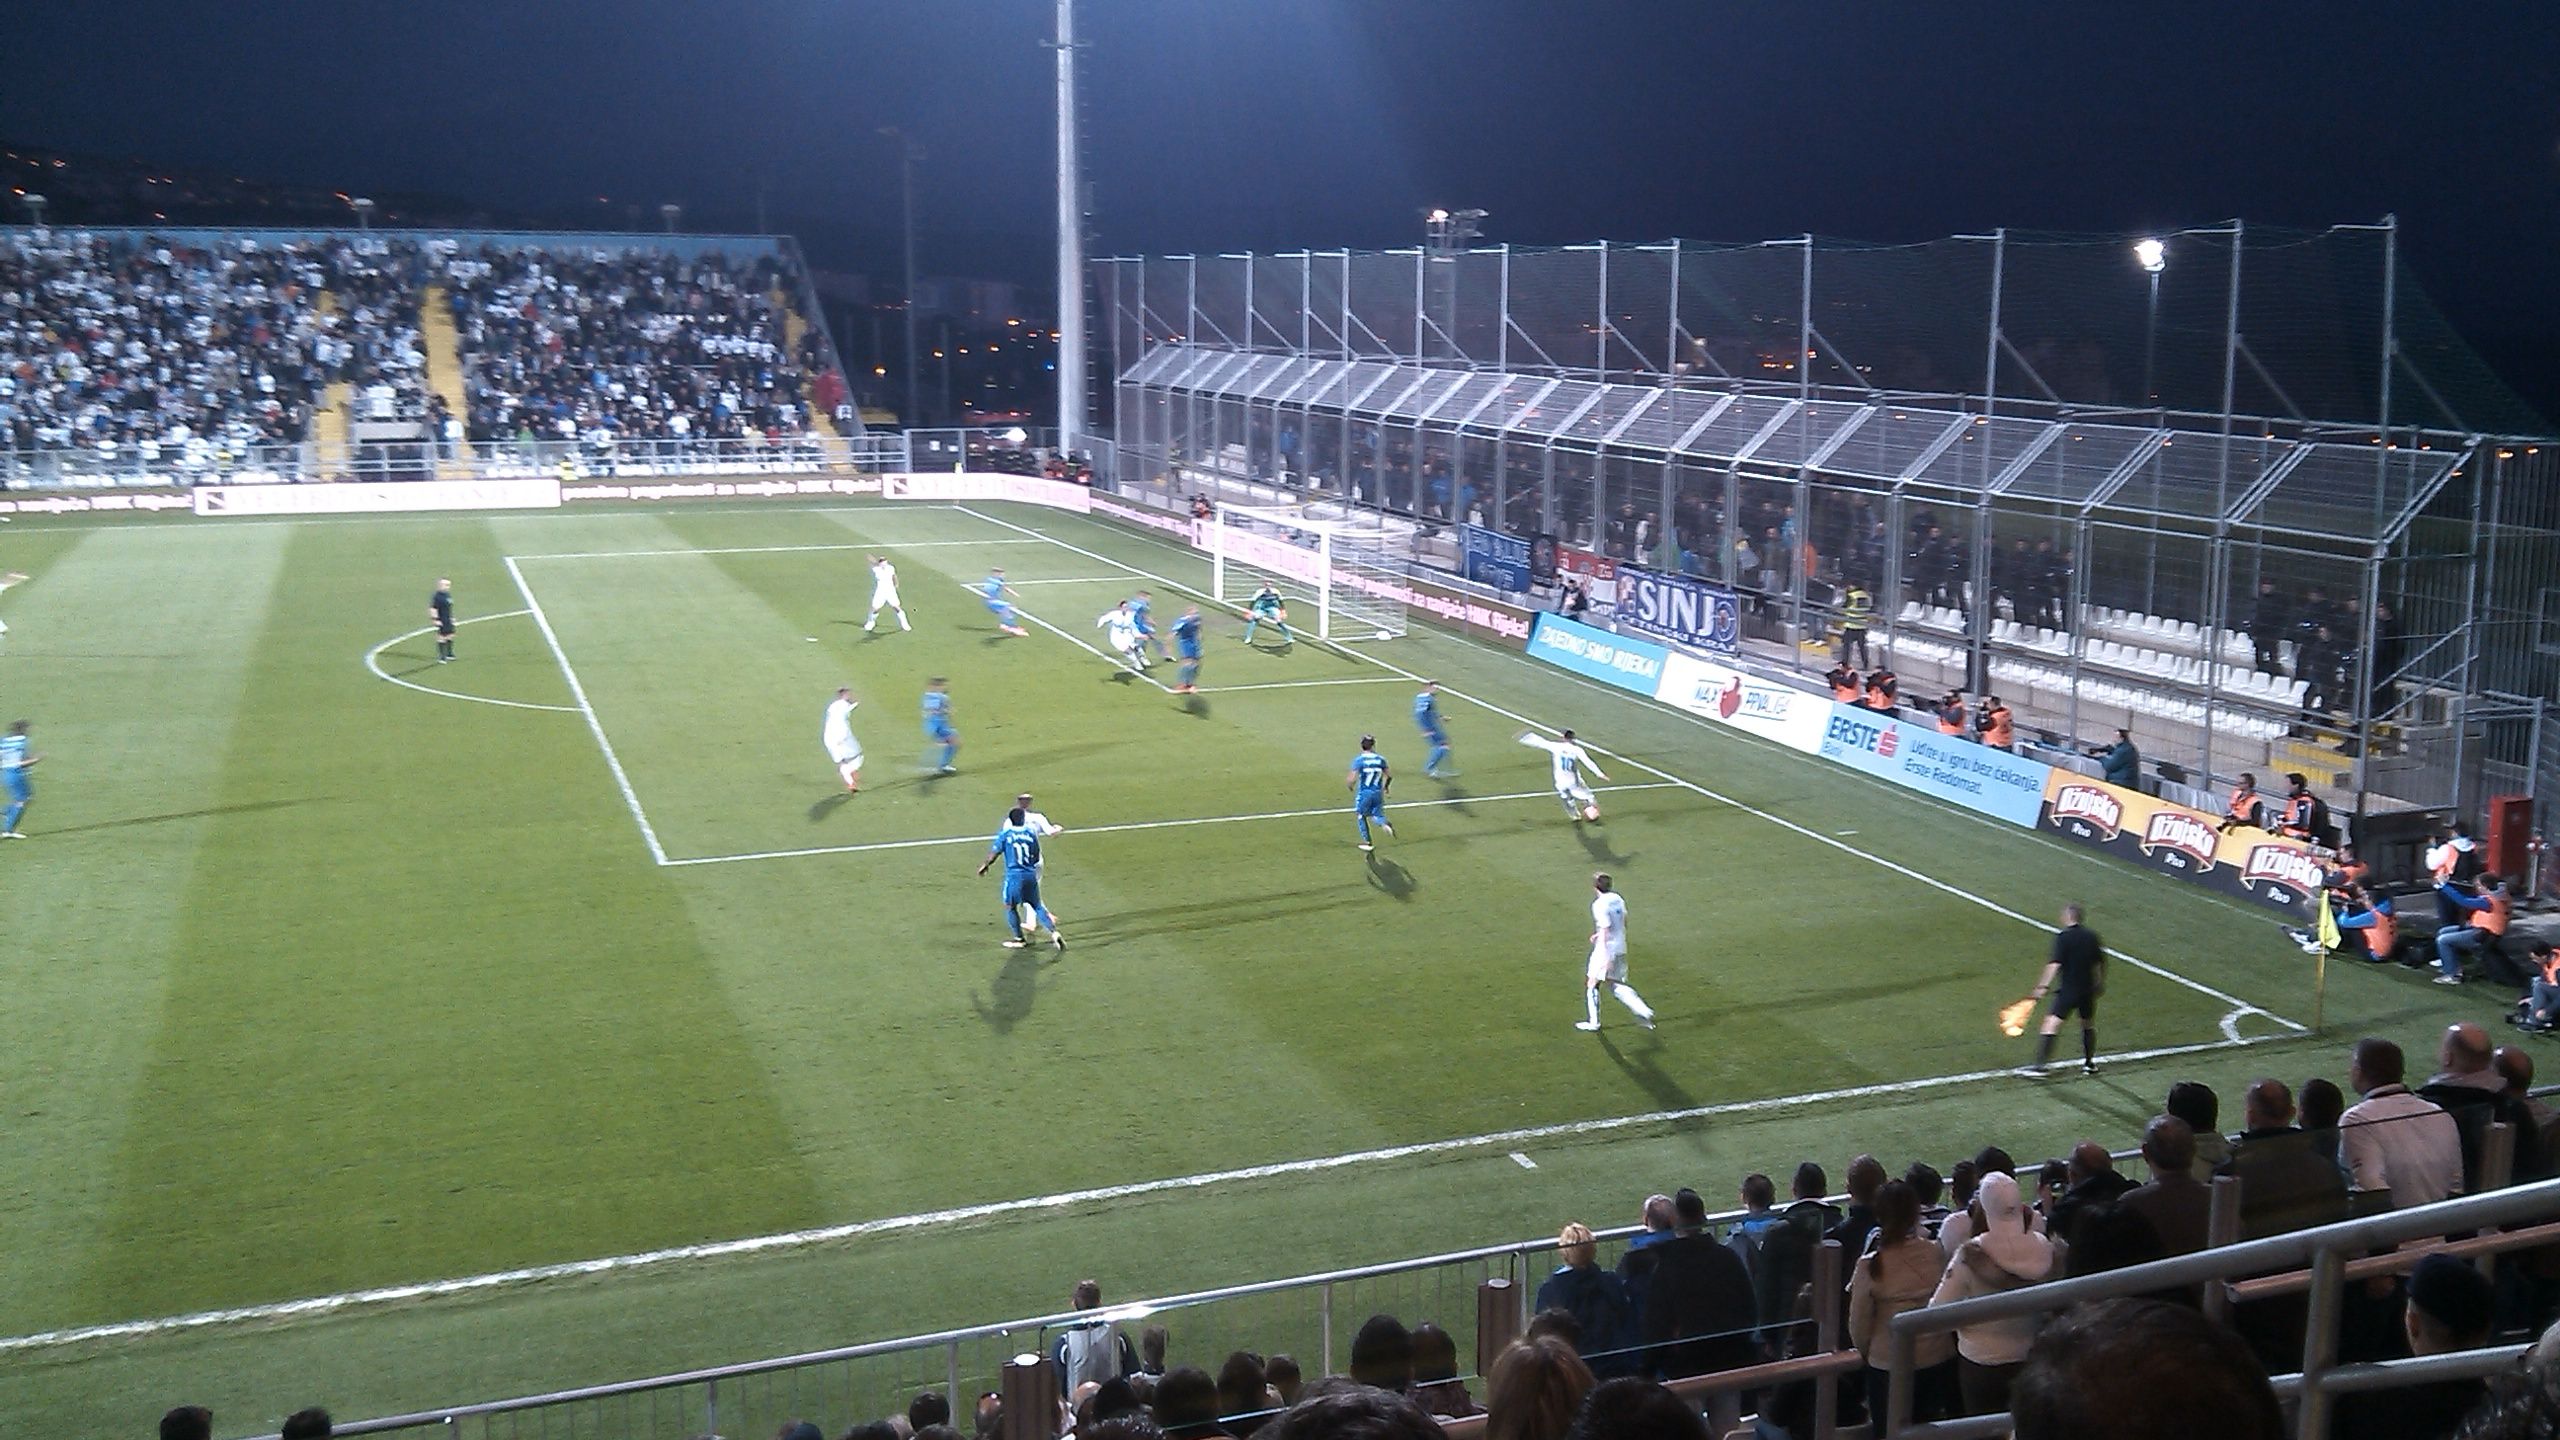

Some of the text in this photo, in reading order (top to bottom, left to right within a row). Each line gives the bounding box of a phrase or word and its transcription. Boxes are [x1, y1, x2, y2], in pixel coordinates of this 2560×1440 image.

[1637, 580, 1716, 637] SINJ
[1828, 715, 1880, 753] ERSTE
[1362, 767, 1383, 787] 77
[1561, 756, 1576, 772] 10
[1904, 757, 1931, 777] Erste
[1974, 758, 1993, 777] bez
[2057, 785, 2119, 826] Ožujsko
[2150, 813, 2216, 858] Ožujsko
[2250, 845, 2324, 889] Ožujsko
